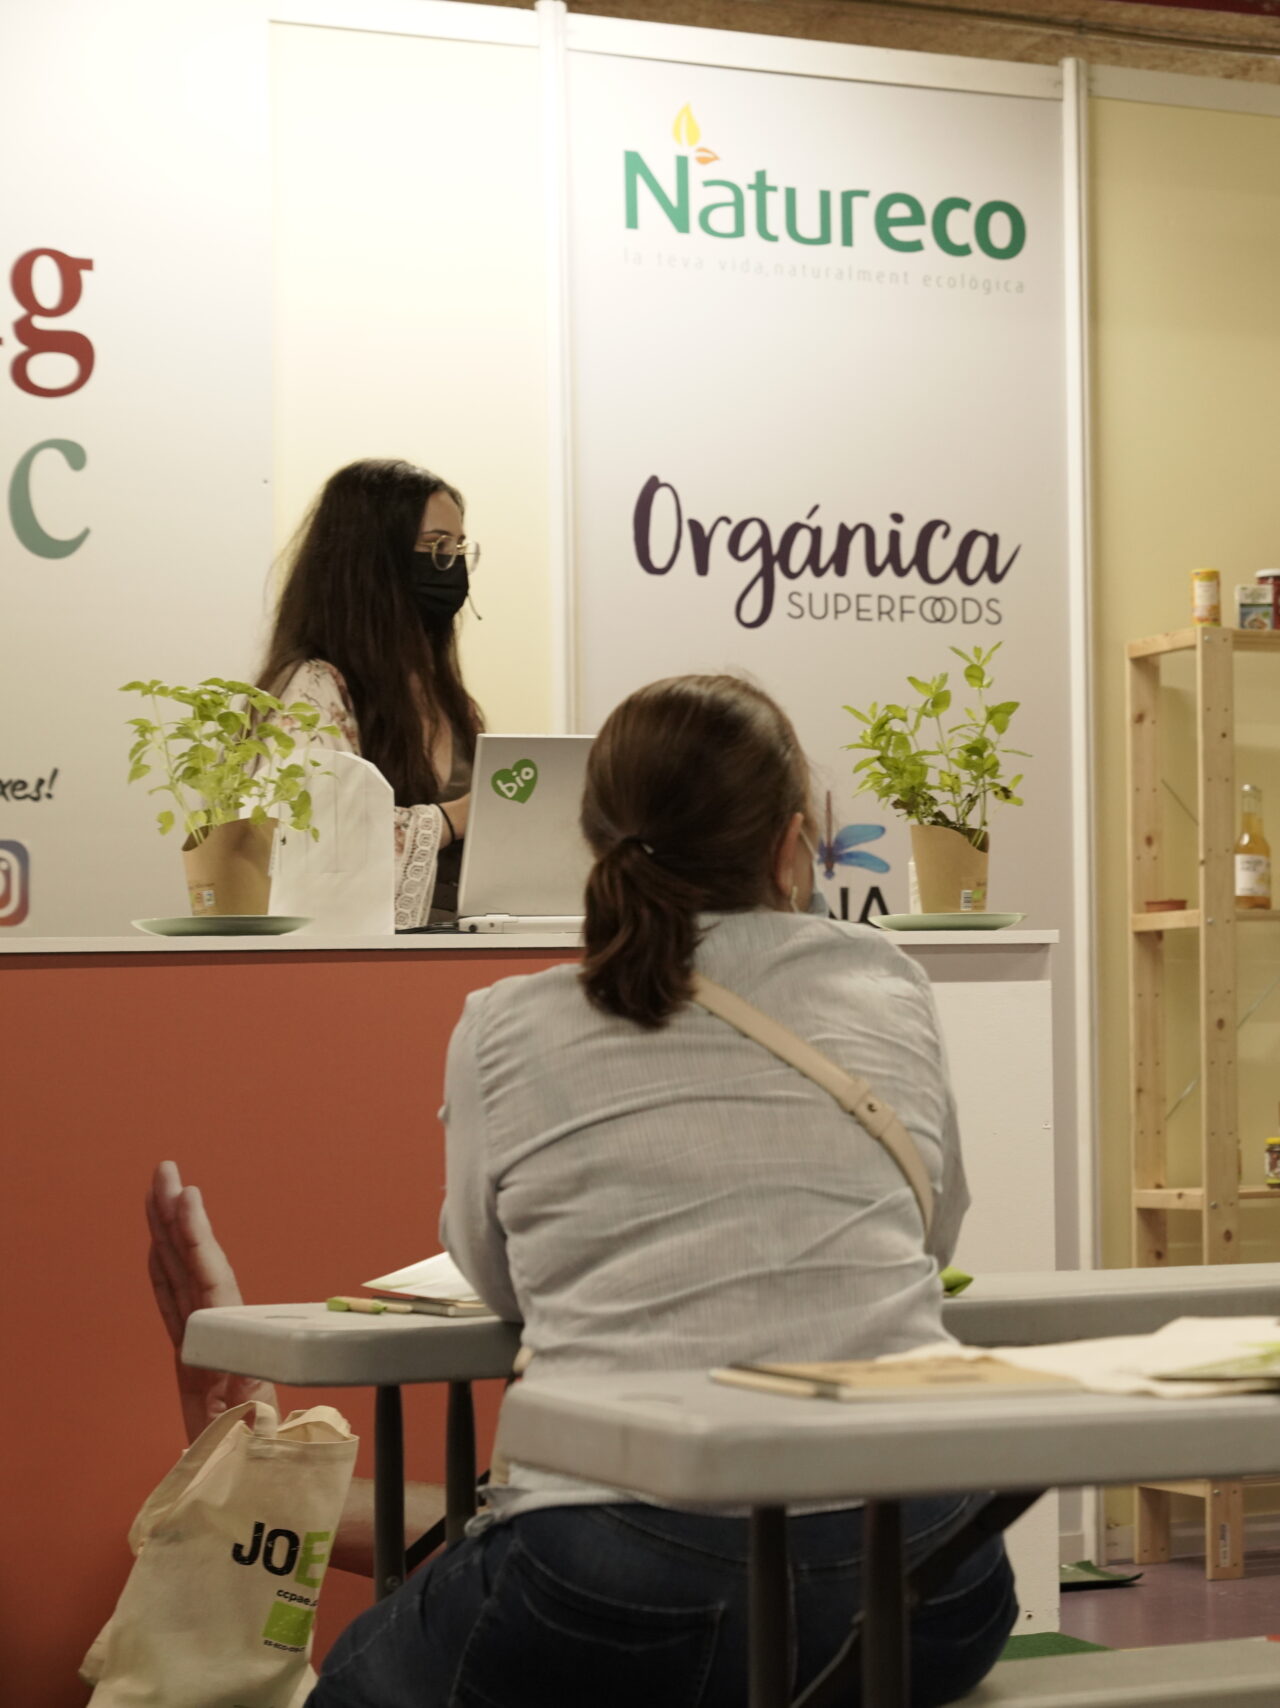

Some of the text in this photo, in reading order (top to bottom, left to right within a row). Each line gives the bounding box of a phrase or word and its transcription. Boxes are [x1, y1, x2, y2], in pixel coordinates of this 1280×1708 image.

[623, 149, 1027, 260] Natureco
[624, 247, 643, 266] la
[657, 252, 705, 271] teva
[0, 247, 95, 398] g
[633, 474, 1022, 629] Orgánica
[787, 591, 1002, 625] SUPERFOODS
[497, 767, 535, 798] bio
[231, 1521, 331, 1588] JOE
